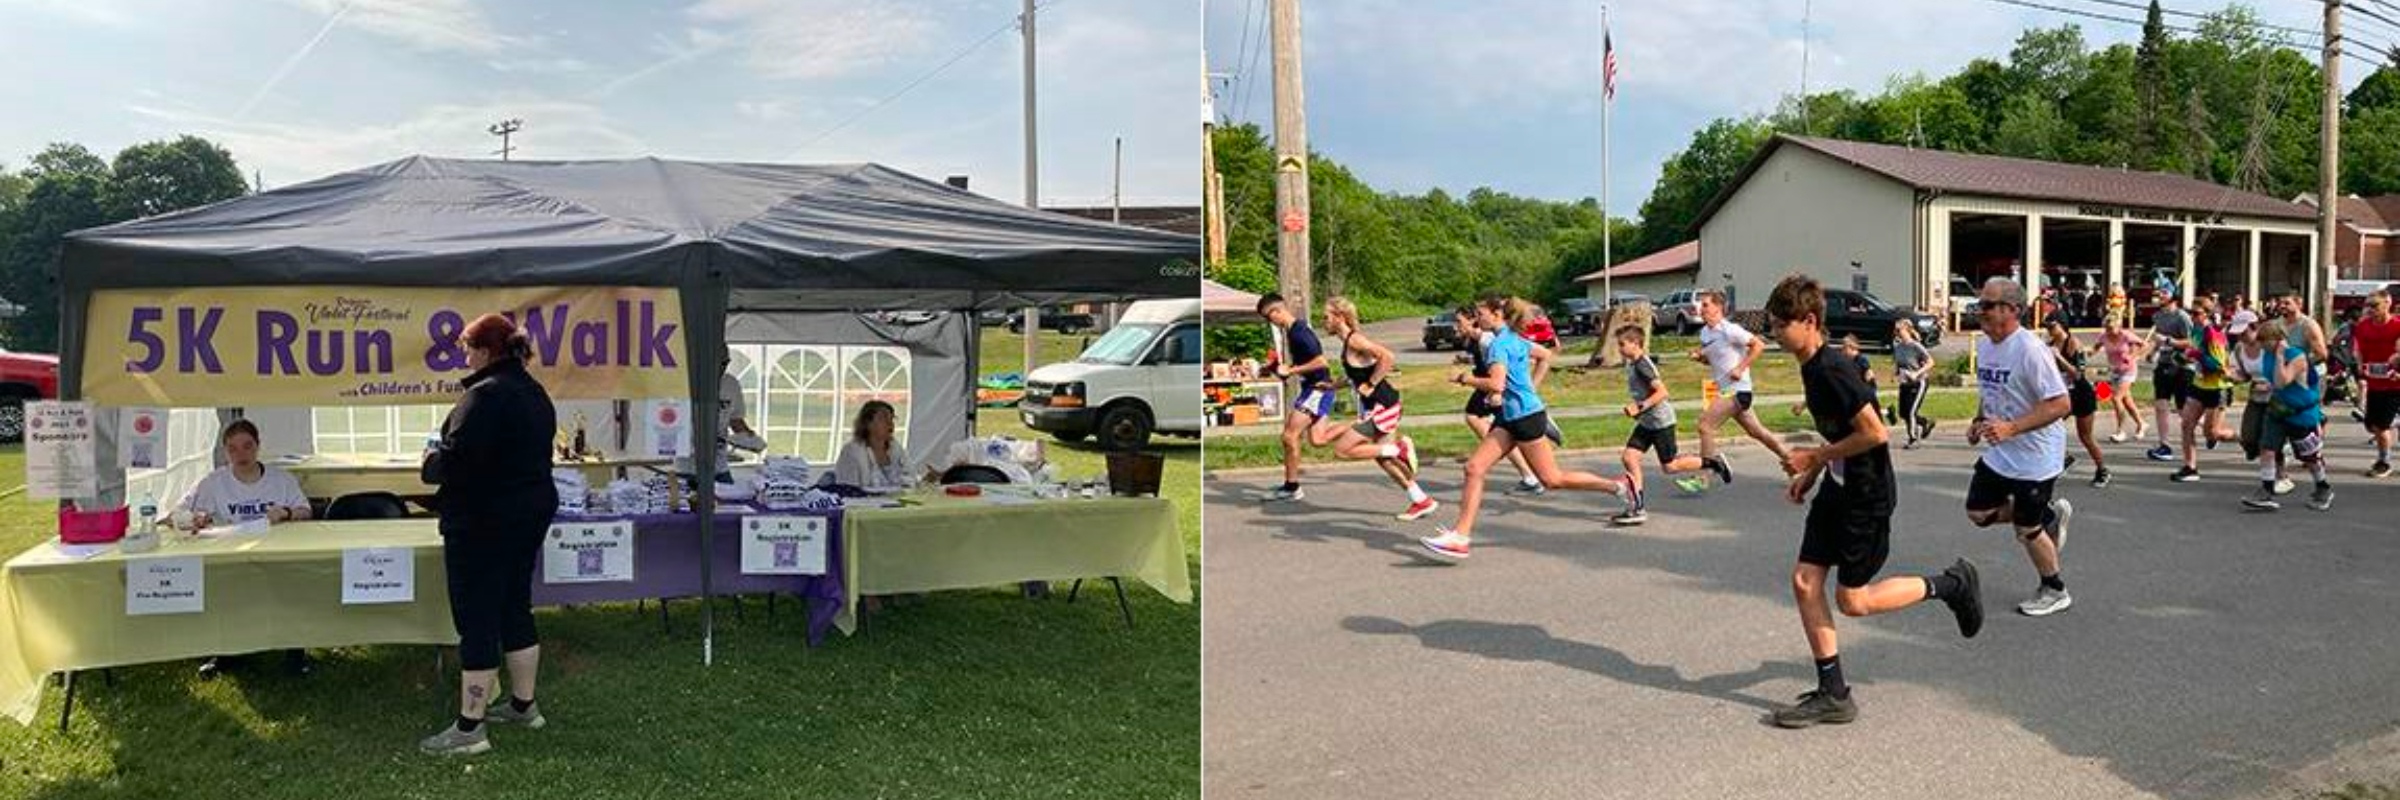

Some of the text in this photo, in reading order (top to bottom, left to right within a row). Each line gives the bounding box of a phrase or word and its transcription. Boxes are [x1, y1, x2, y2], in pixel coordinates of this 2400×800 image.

[125, 299, 678, 376] 5K Run & Walk
[360, 380, 432, 395] Children's
[32, 432, 88, 443] Sponsors
[227, 502, 269, 515] VIOLE
